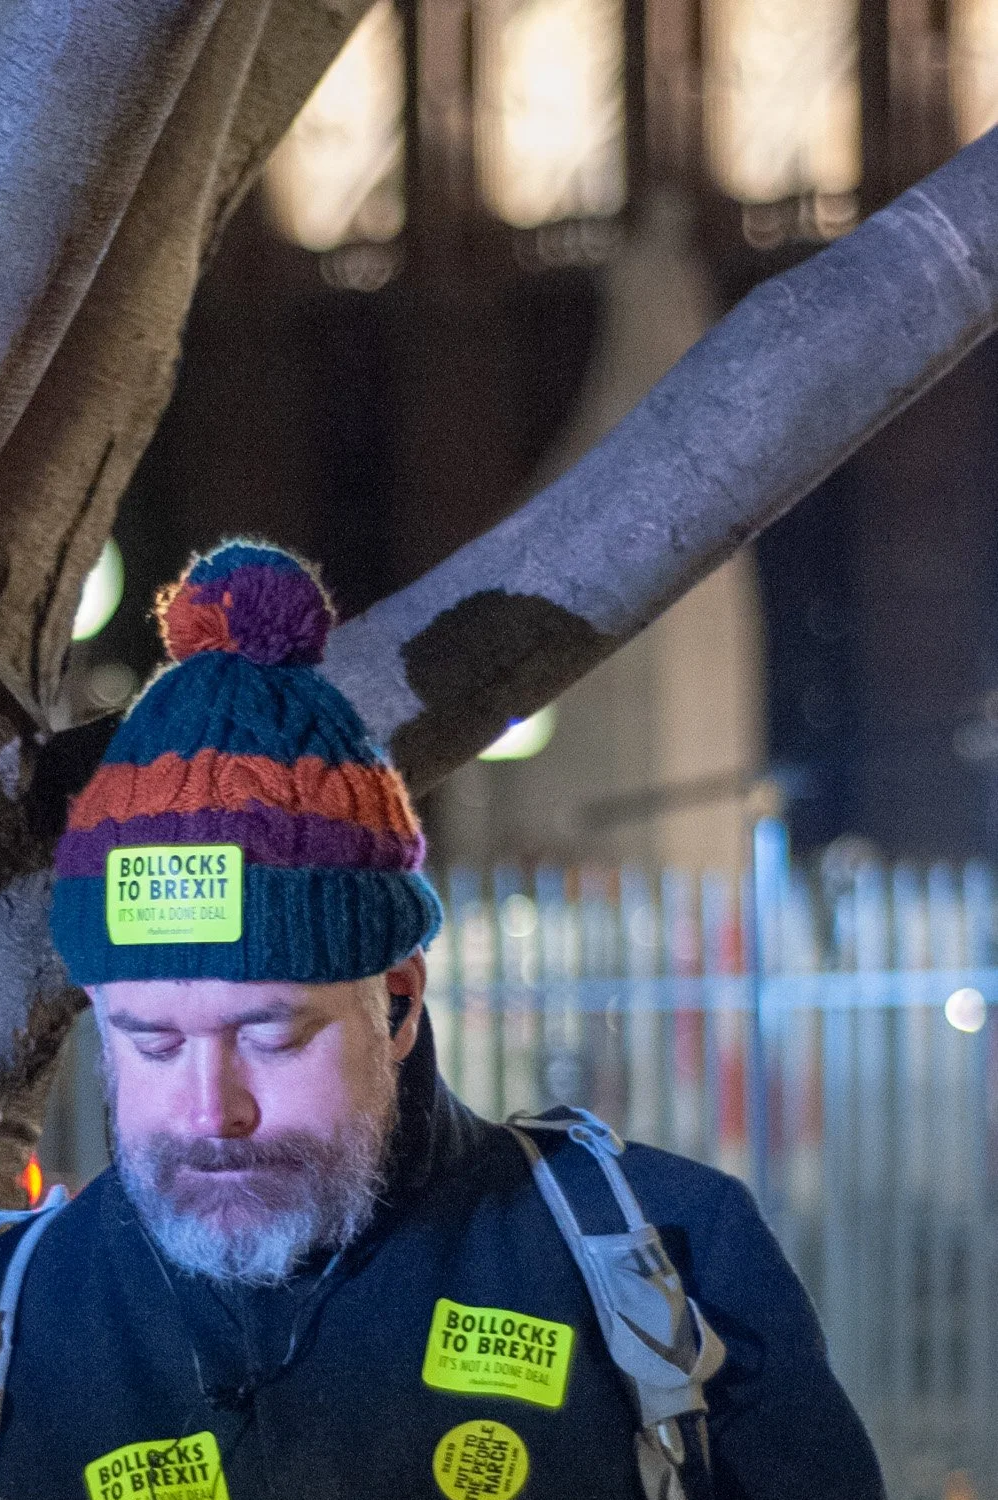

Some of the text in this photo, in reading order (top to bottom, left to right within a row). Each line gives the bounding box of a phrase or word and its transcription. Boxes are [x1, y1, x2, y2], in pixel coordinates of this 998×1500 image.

[120, 854, 227, 878] BOLLOCKS
[118, 878, 228, 901] TO BREXIT
[137, 907, 156, 921] NOT
[158, 907, 165, 920] A
[169, 906, 197, 920] DONE
[200, 906, 226, 920] DEAL
[445, 1309, 558, 1347] BOLLOCKS
[441, 1330, 557, 1368] TO BREXIT
[460, 1360, 480, 1373] NOT
[483, 1362, 491, 1373] A
[493, 1361, 523, 1378] DONE
[525, 1368, 550, 1386] DEAL
[130, 1462, 209, 1492] BREXIT
[454, 1434, 477, 1489] PUT IT TO
[465, 1425, 495, 1500] THE PEOPLE
[482, 1440, 509, 1494] MARCH
